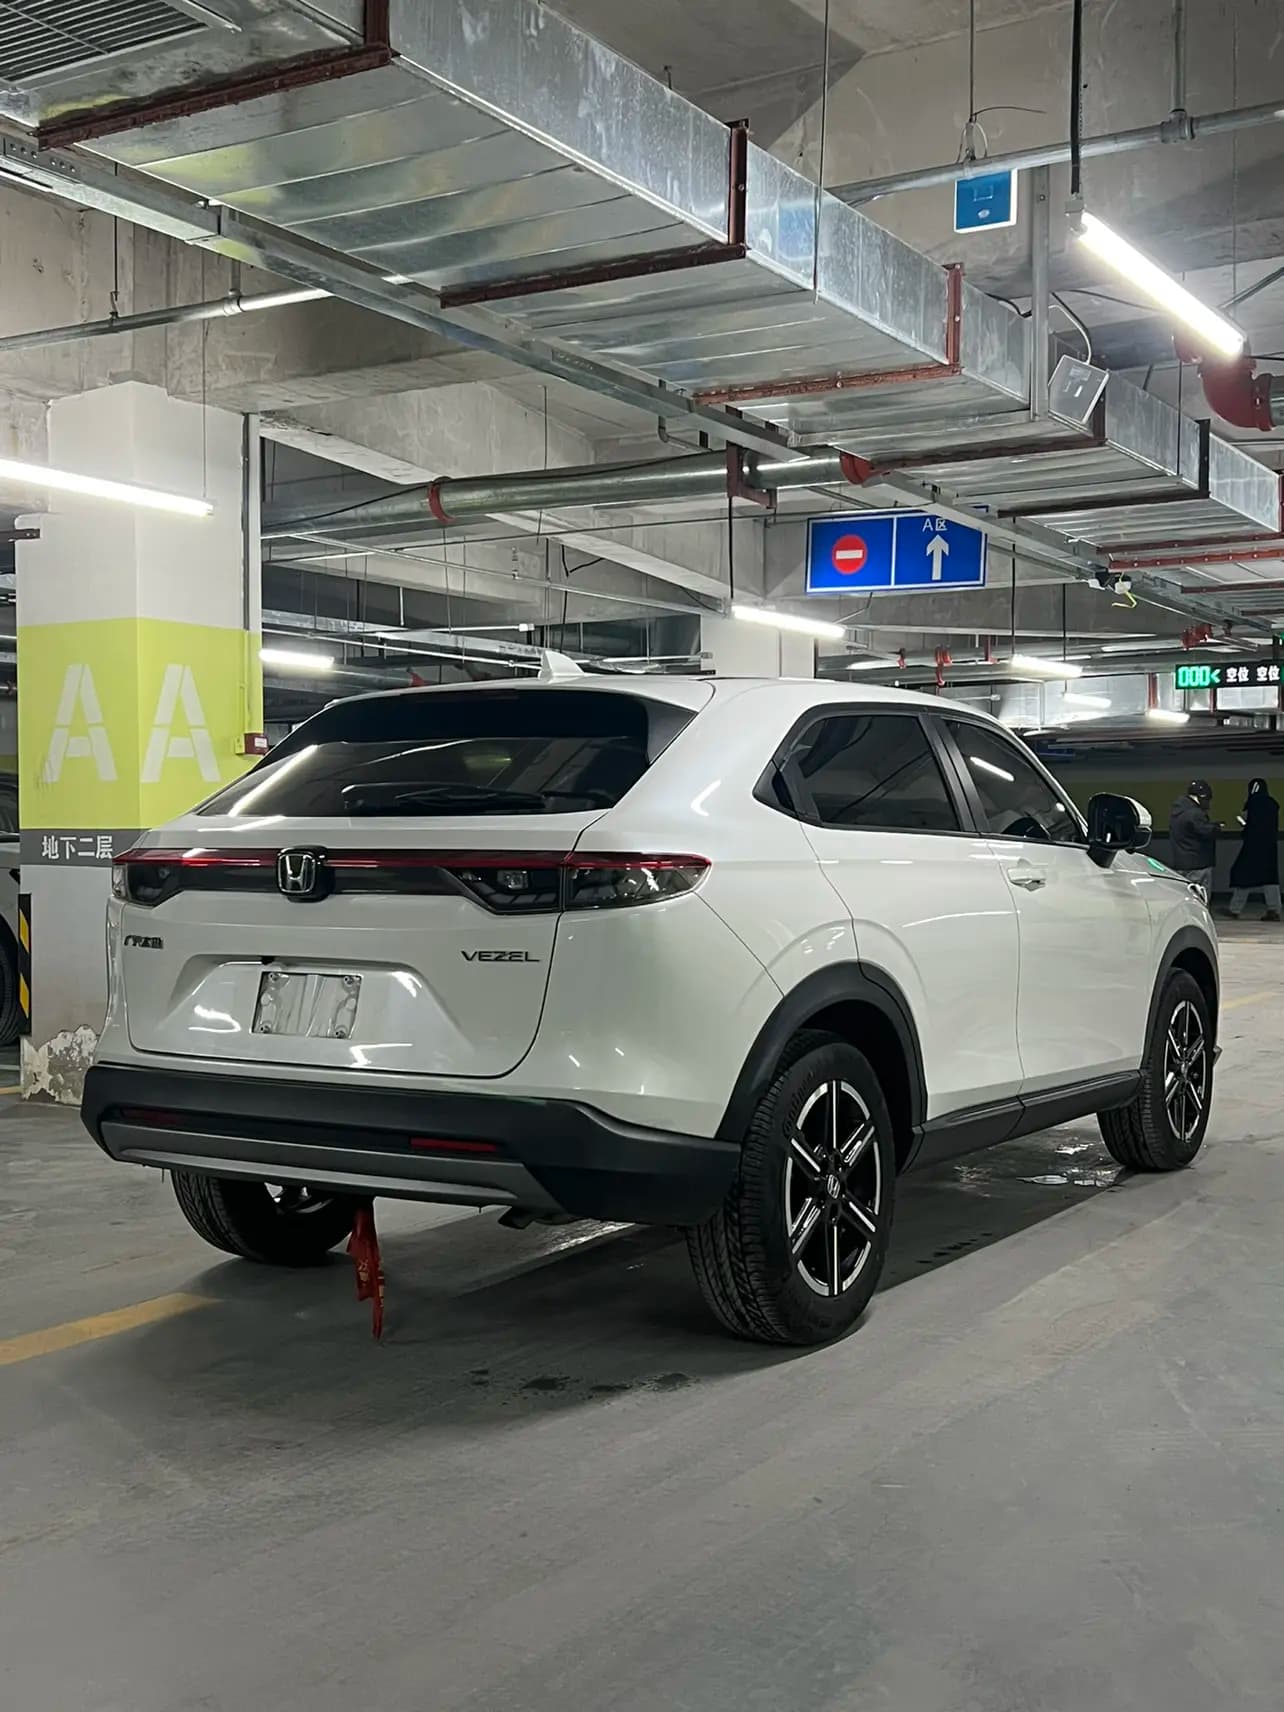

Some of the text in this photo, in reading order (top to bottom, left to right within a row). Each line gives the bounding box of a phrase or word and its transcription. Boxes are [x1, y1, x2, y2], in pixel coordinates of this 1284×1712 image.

[922, 518, 948, 532] A区
[1226, 667, 1249, 682] 空位
[1257, 665, 1280, 681] 空位
[42, 663, 118, 784] A
[140, 663, 221, 783] A
[42, 835, 113, 860] 地下二层
[460, 950, 541, 962] VEZEL
